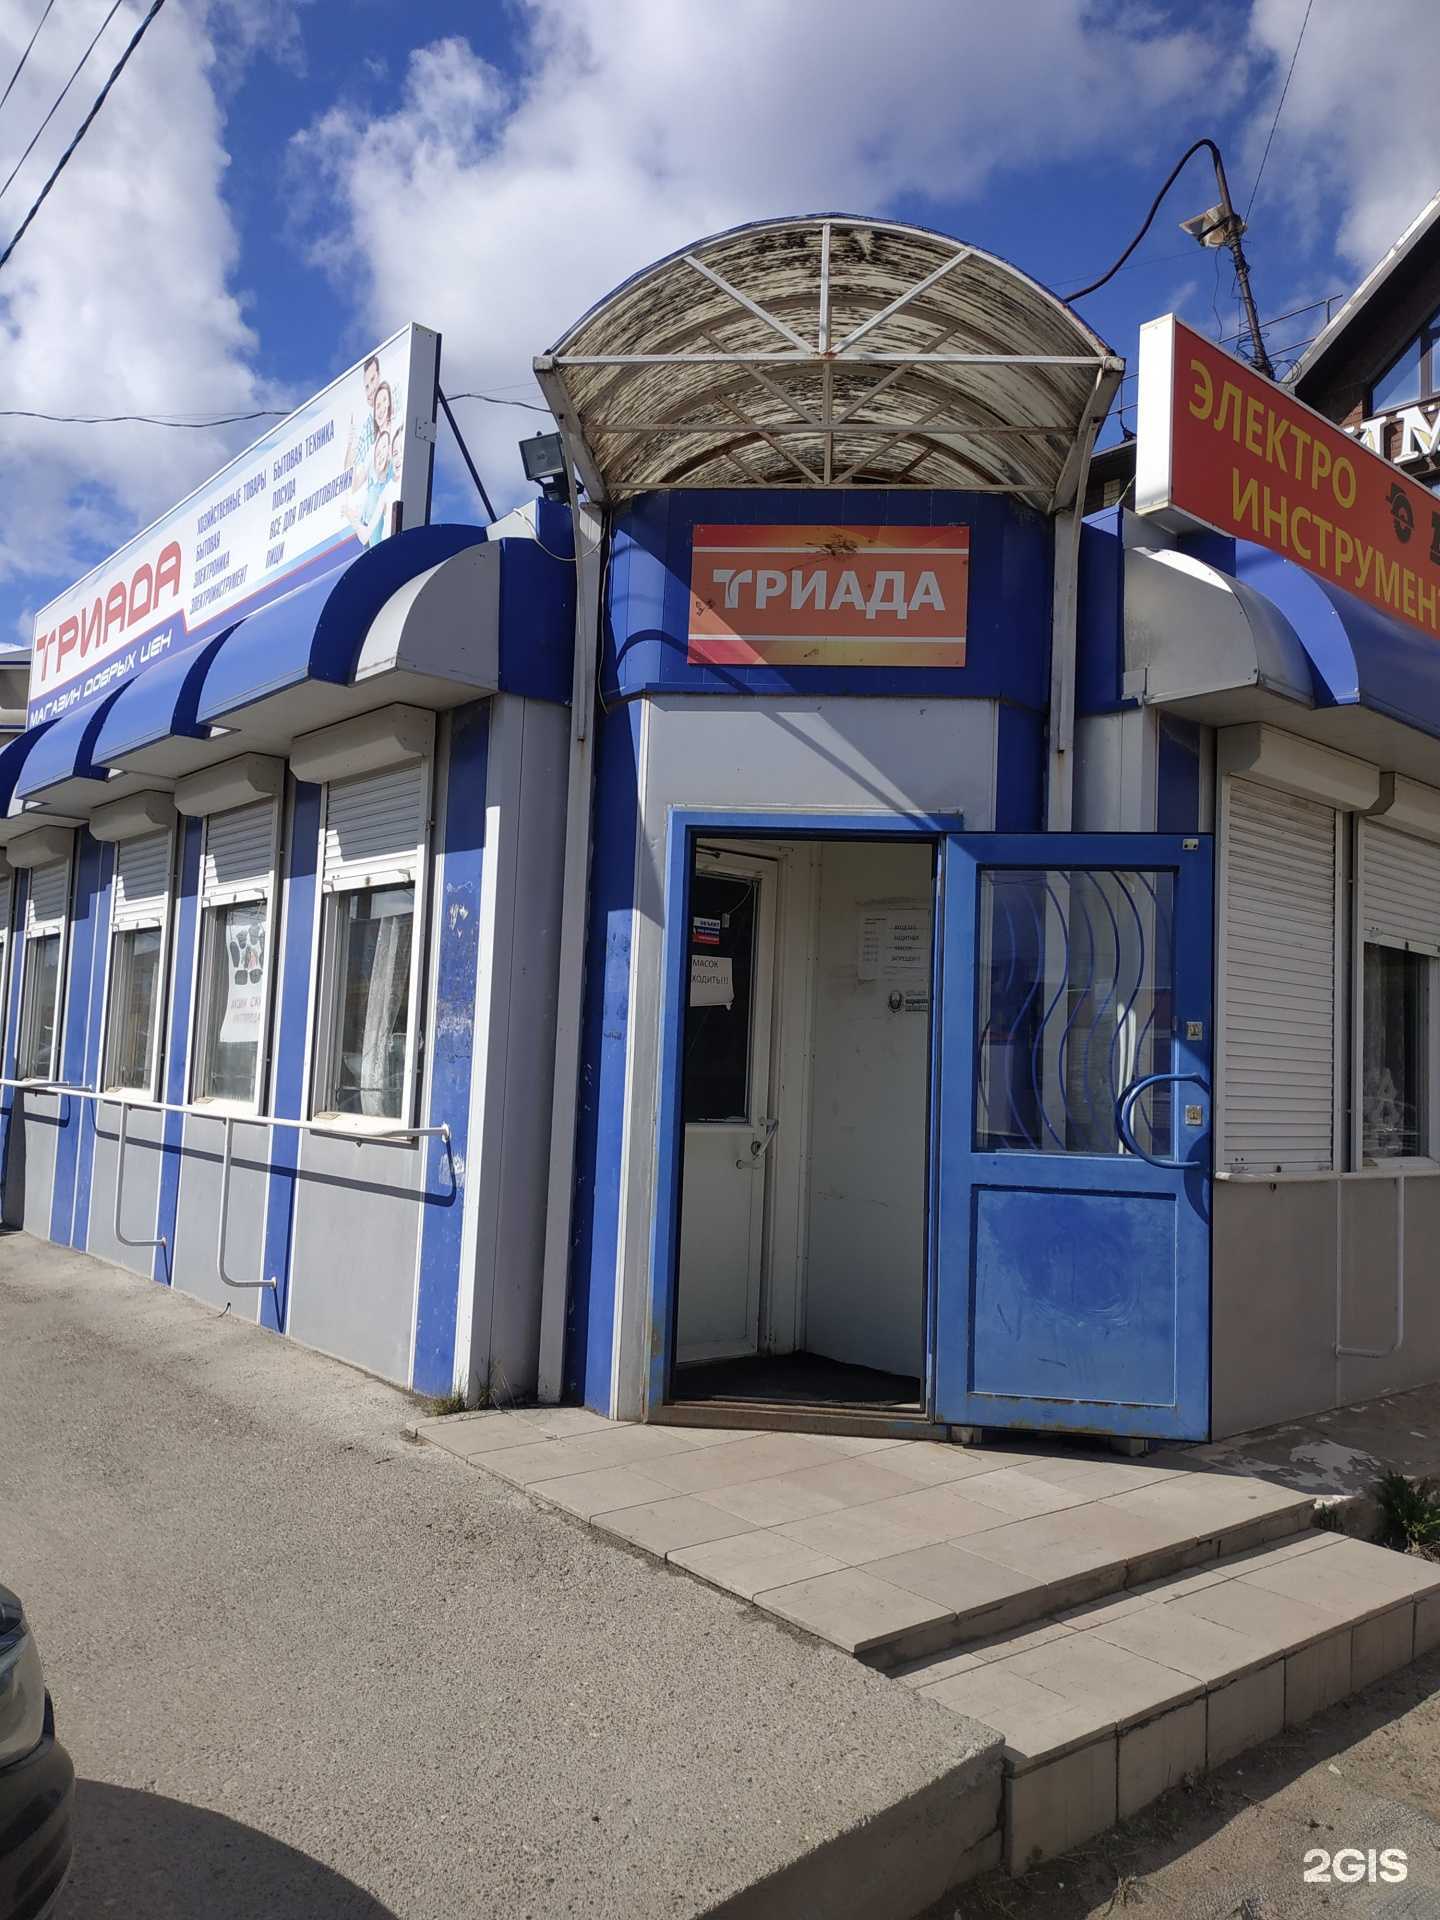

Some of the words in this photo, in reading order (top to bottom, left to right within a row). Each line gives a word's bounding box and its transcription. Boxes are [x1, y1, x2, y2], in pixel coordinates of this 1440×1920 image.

[273, 443, 303, 482] БЫТОВАЯ
[305, 419, 335, 458] ТЕХНИКА
[1188, 359, 1357, 509] ЭЛЕКТРО
[243, 468, 267, 504] ТОВАРЫ
[268, 515, 283, 540] ВСЕ
[298, 466, 354, 522] ПРИГОТОВЛЕНИЯ
[272, 477, 297, 511] ПОСУДА
[1232, 467, 1440, 630] ИНСТРУМЕН
[37, 541, 182, 682] ТРИАДА
[712, 569, 946, 619] ТРИАДА
[30, 684, 82, 727] МАГАЗИН
[83, 651, 137, 697] ДОБРЫХ
[140, 628, 172, 664] ЦЕН
[692, 959, 719, 969] МАСОК
